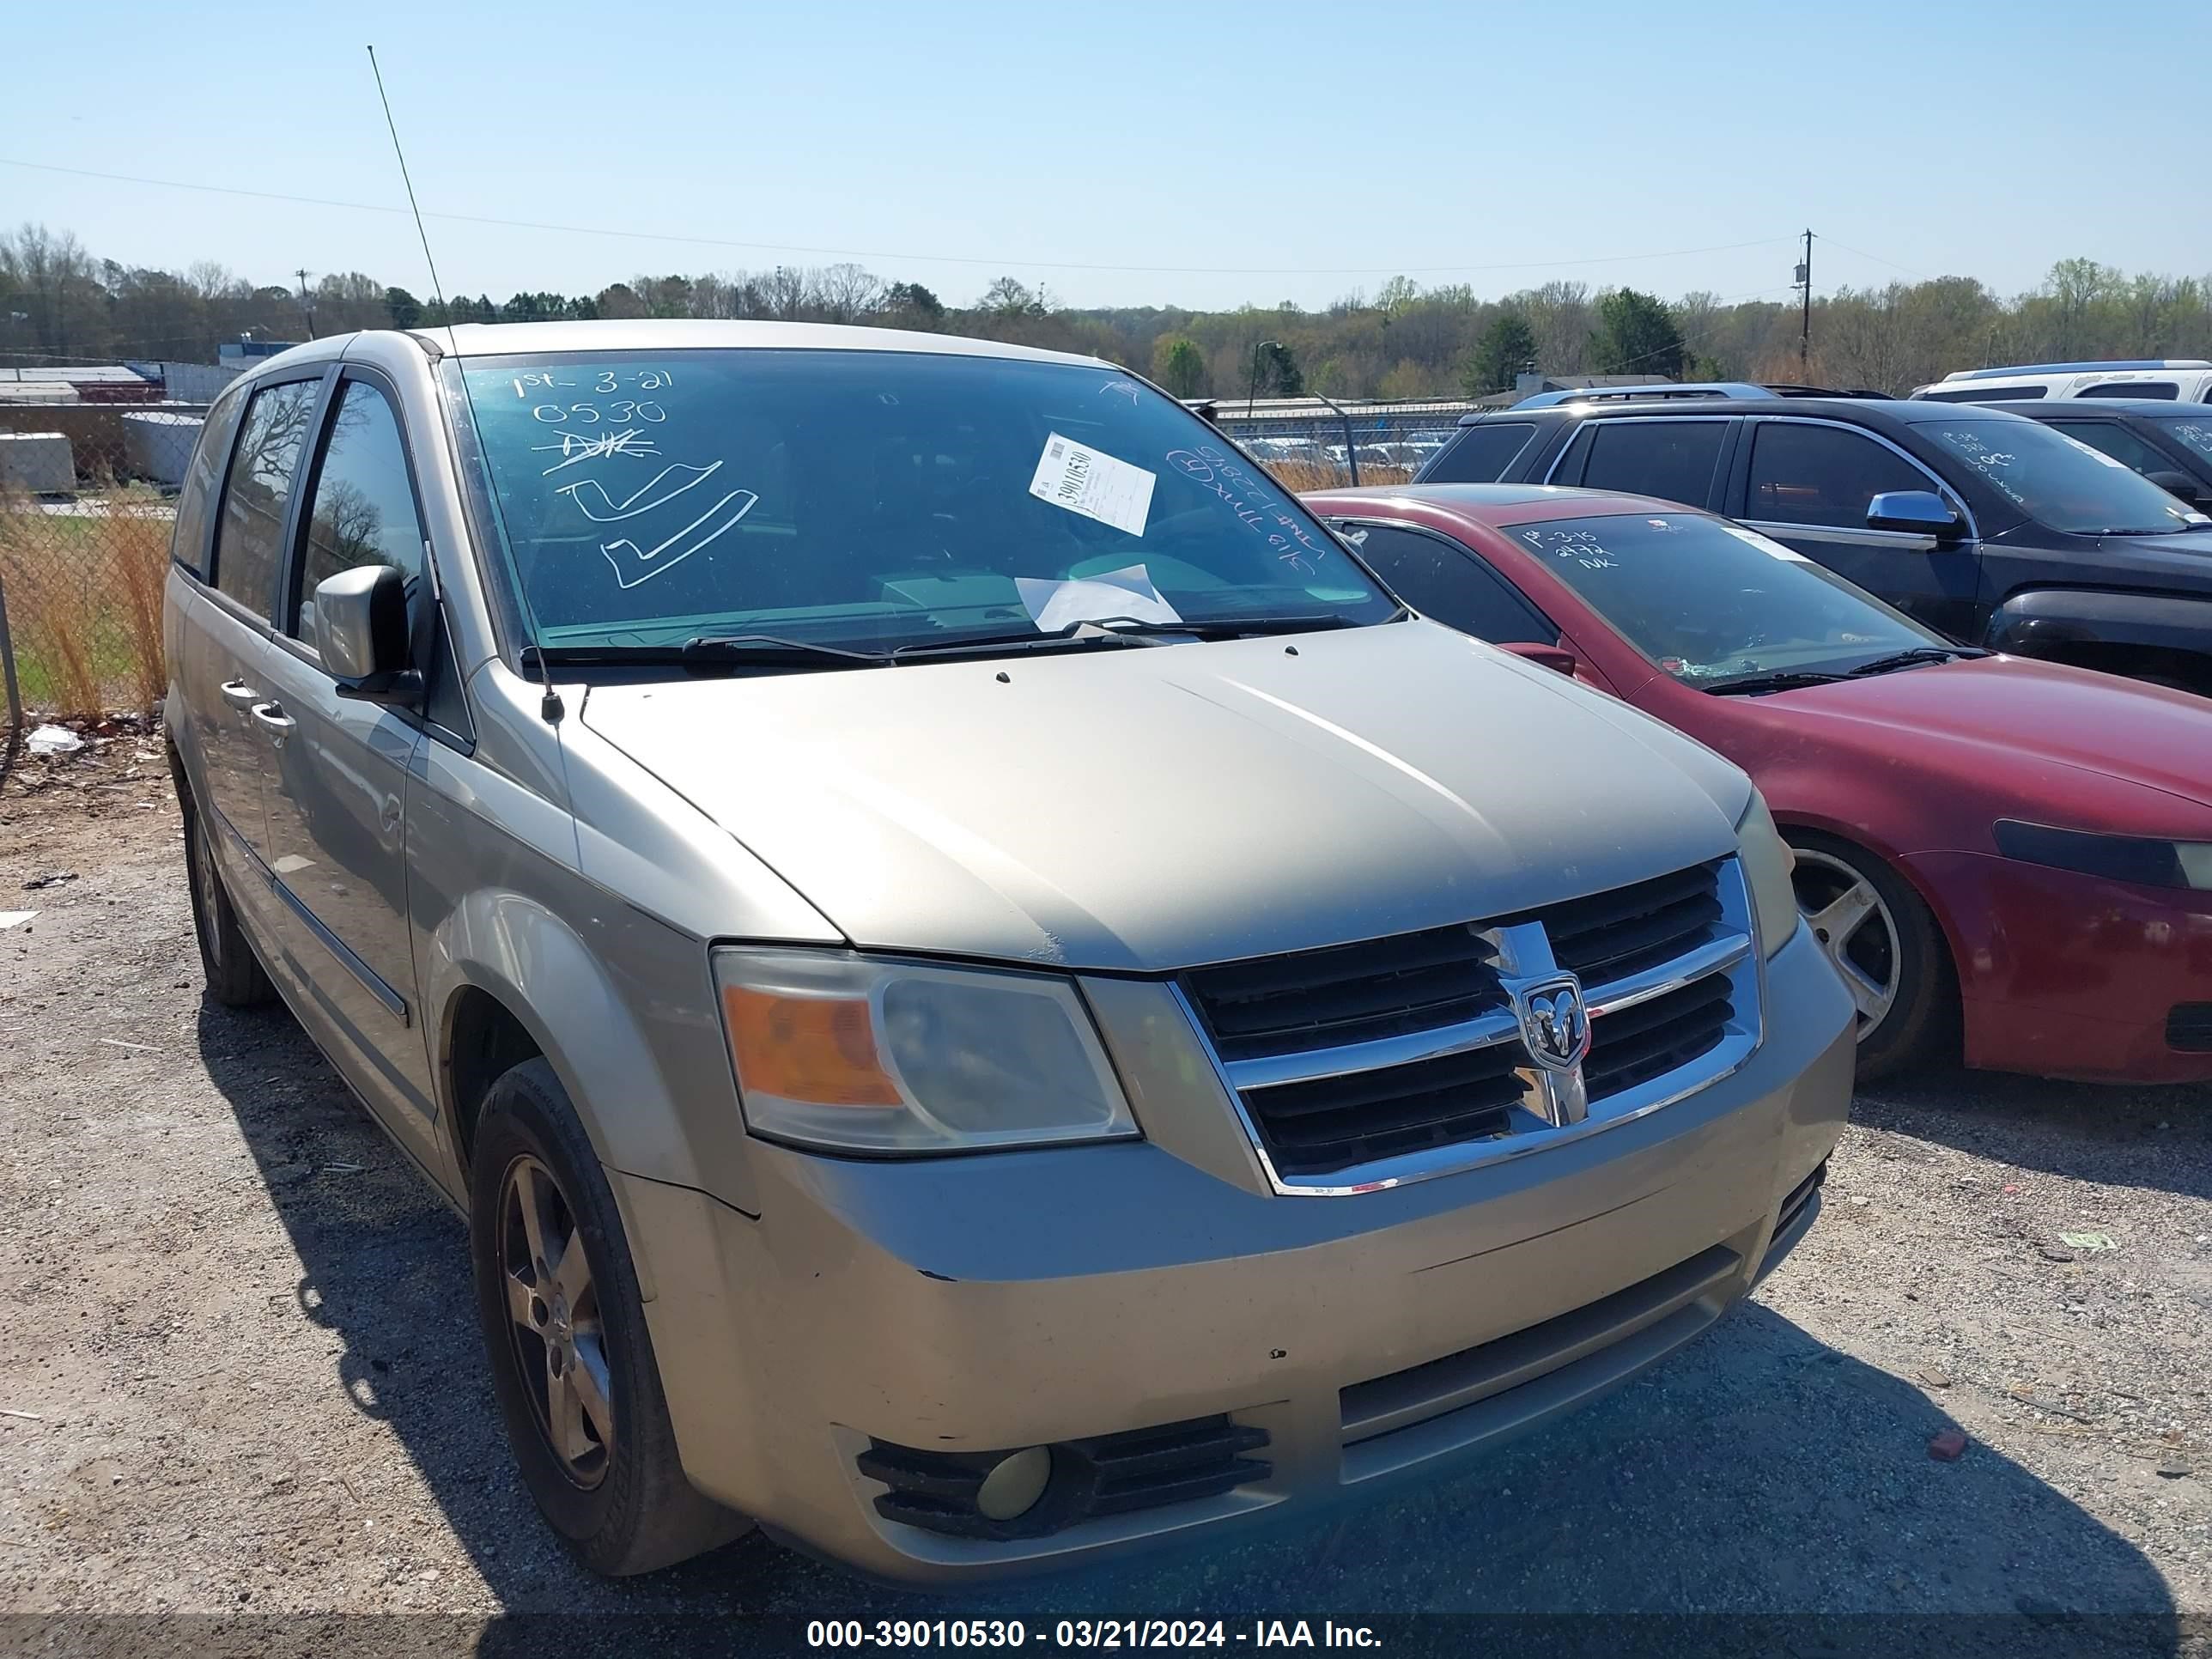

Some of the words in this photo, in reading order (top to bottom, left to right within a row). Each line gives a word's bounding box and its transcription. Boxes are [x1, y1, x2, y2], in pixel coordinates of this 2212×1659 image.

[532, 400, 667, 423] 0530
[1057, 450, 1093, 505] 39010530
[1555, 544, 1615, 557] 2472
